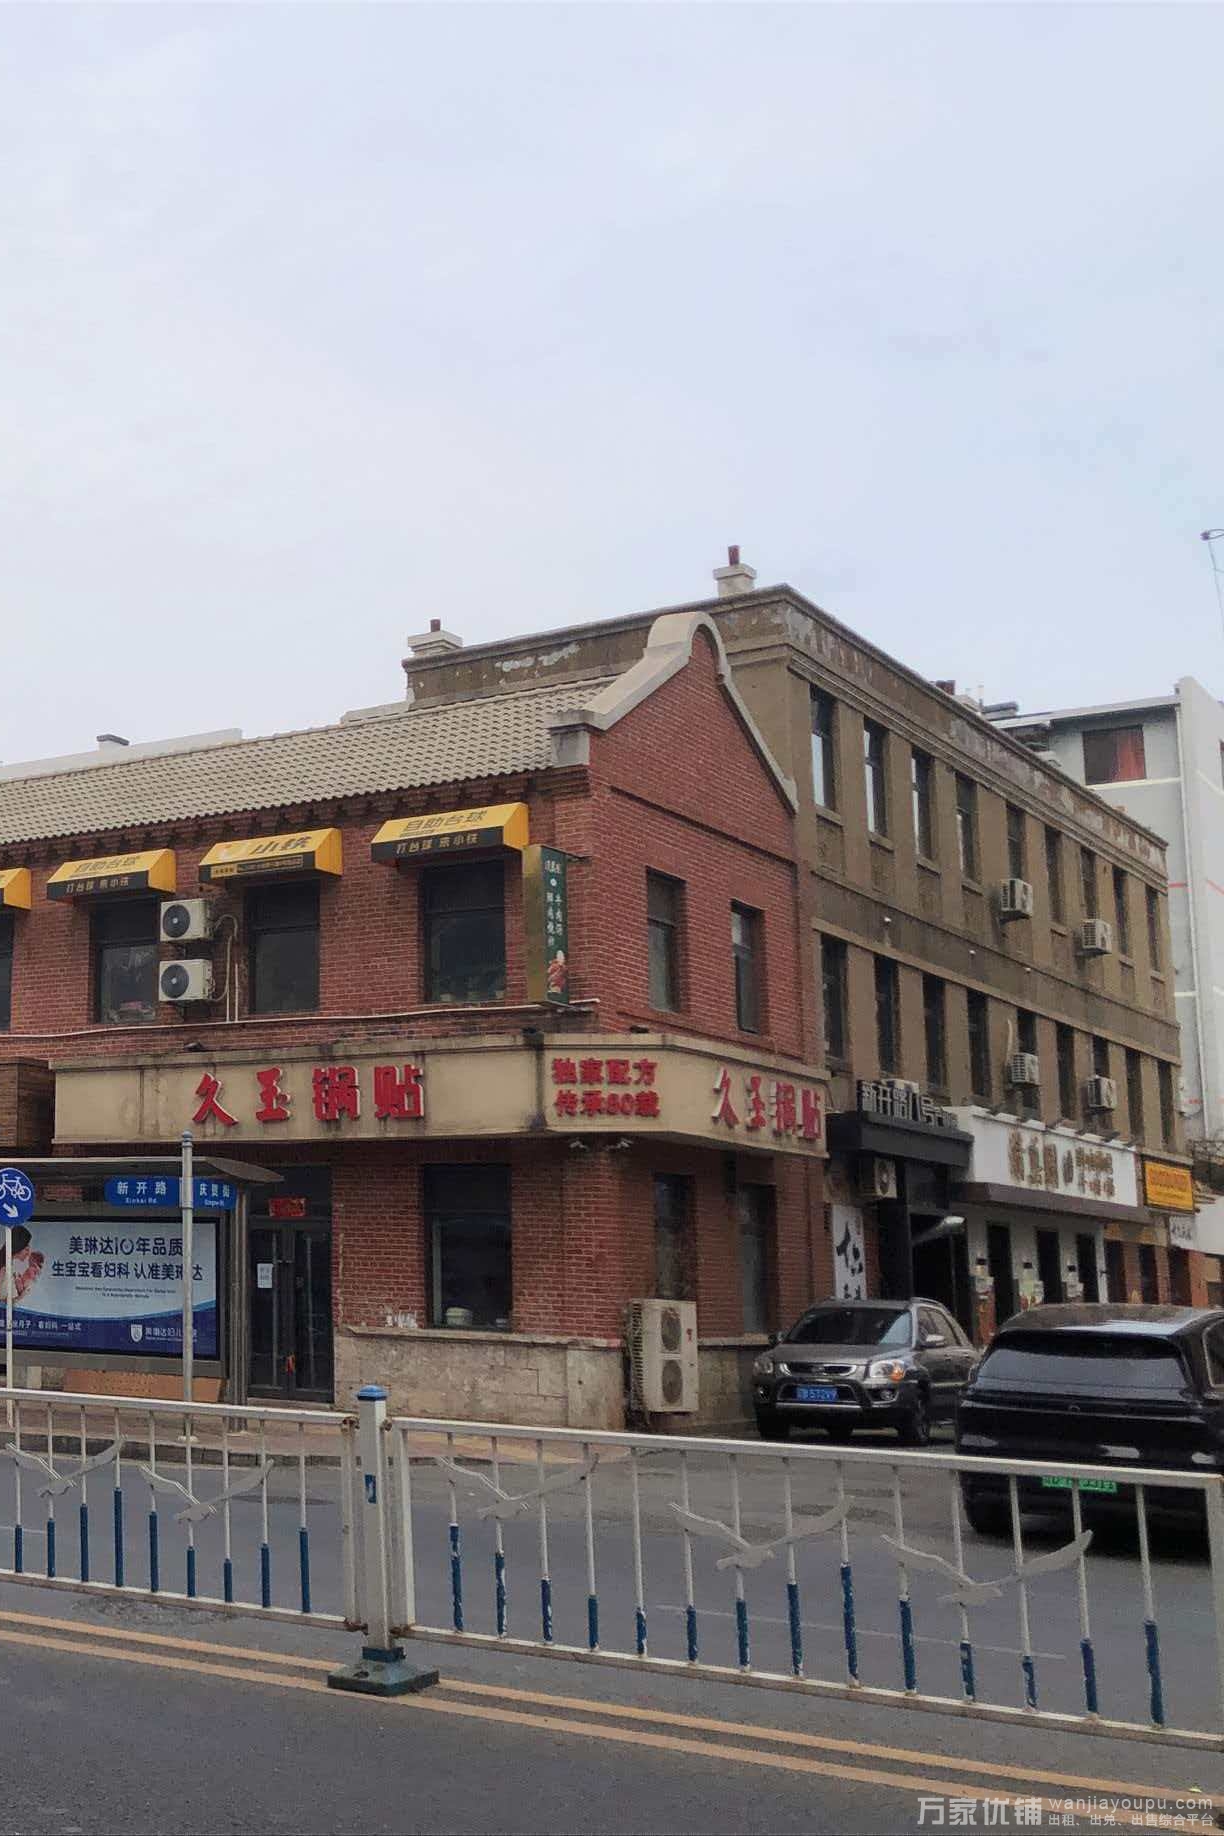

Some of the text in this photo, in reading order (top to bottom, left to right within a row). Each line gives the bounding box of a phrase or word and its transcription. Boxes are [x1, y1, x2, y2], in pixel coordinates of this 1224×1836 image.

[116, 1180, 167, 1196] 新开路
[52, 1261, 130, 1280] 生宝宝看妇科
